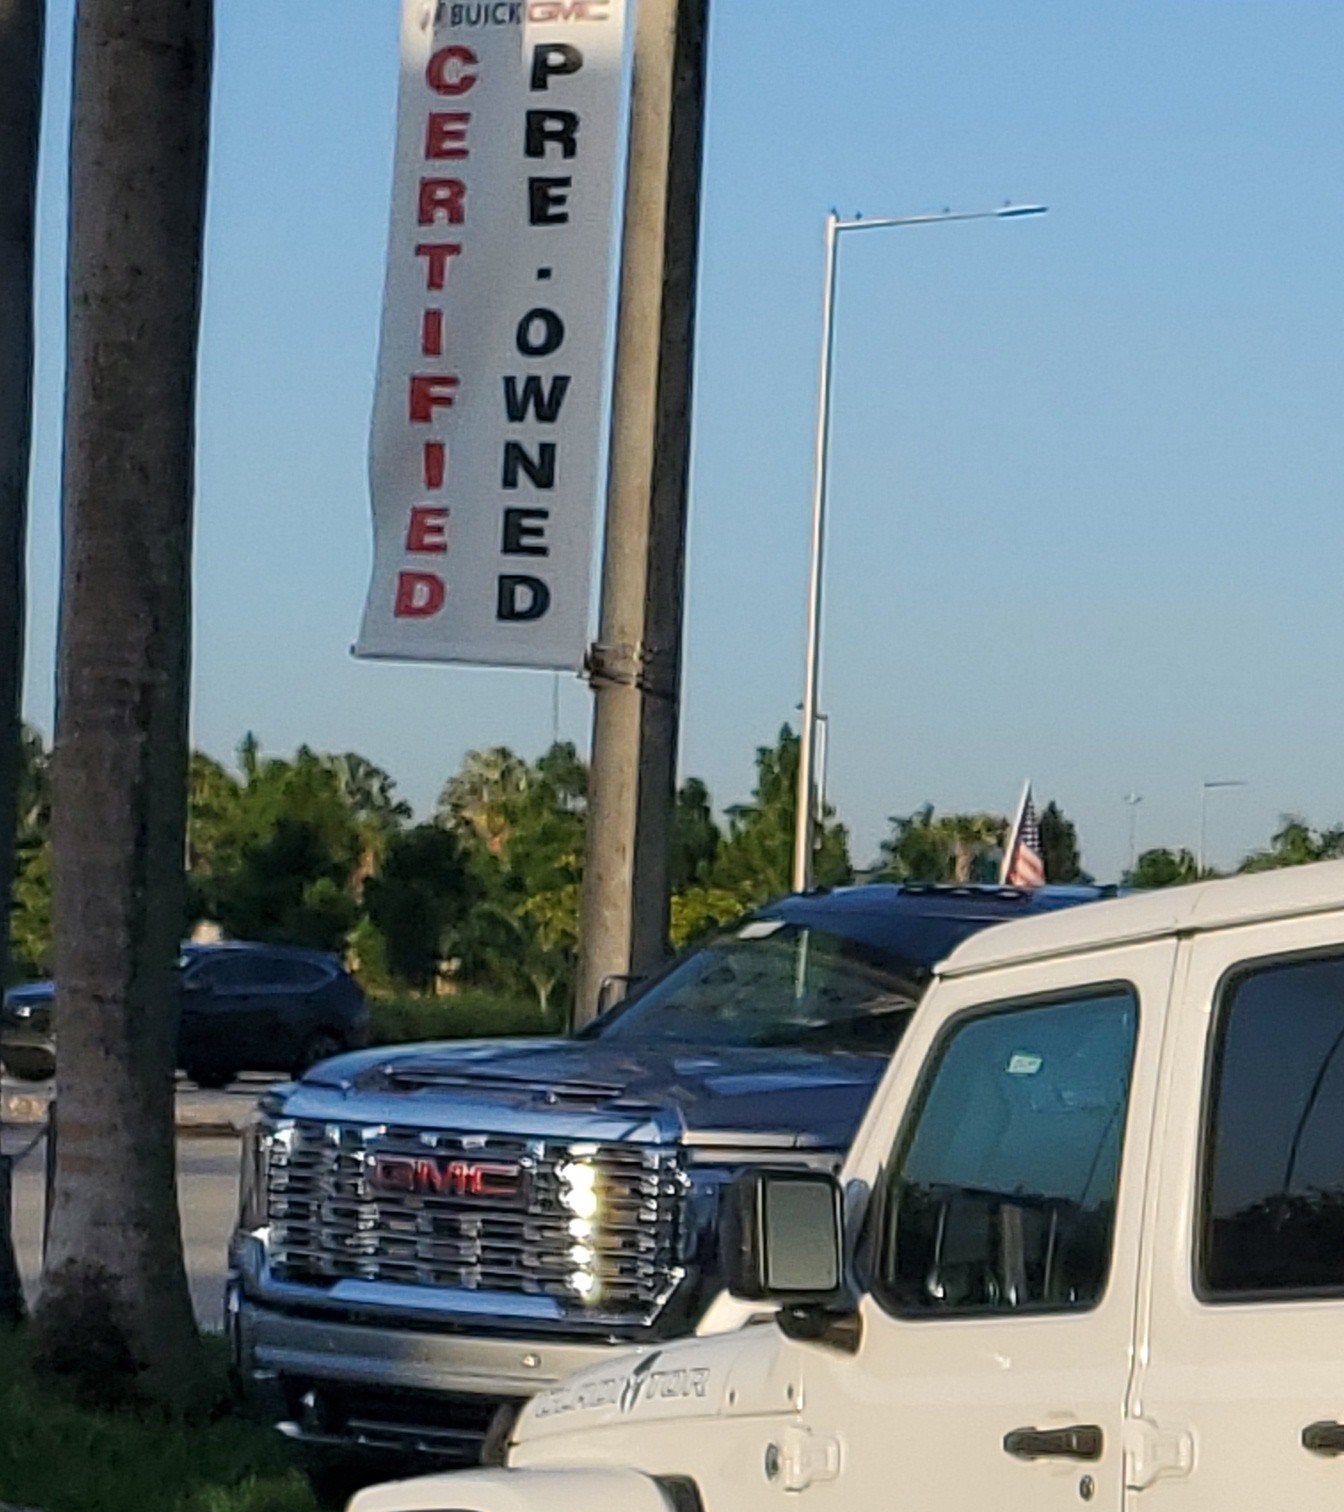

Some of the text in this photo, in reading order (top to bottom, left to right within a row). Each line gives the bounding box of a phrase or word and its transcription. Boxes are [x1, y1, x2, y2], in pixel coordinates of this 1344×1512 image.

[451, 3, 523, 26] BUICK
[393, 44, 479, 620] CERTIFIED
[374, 1155, 522, 1196] GMC
